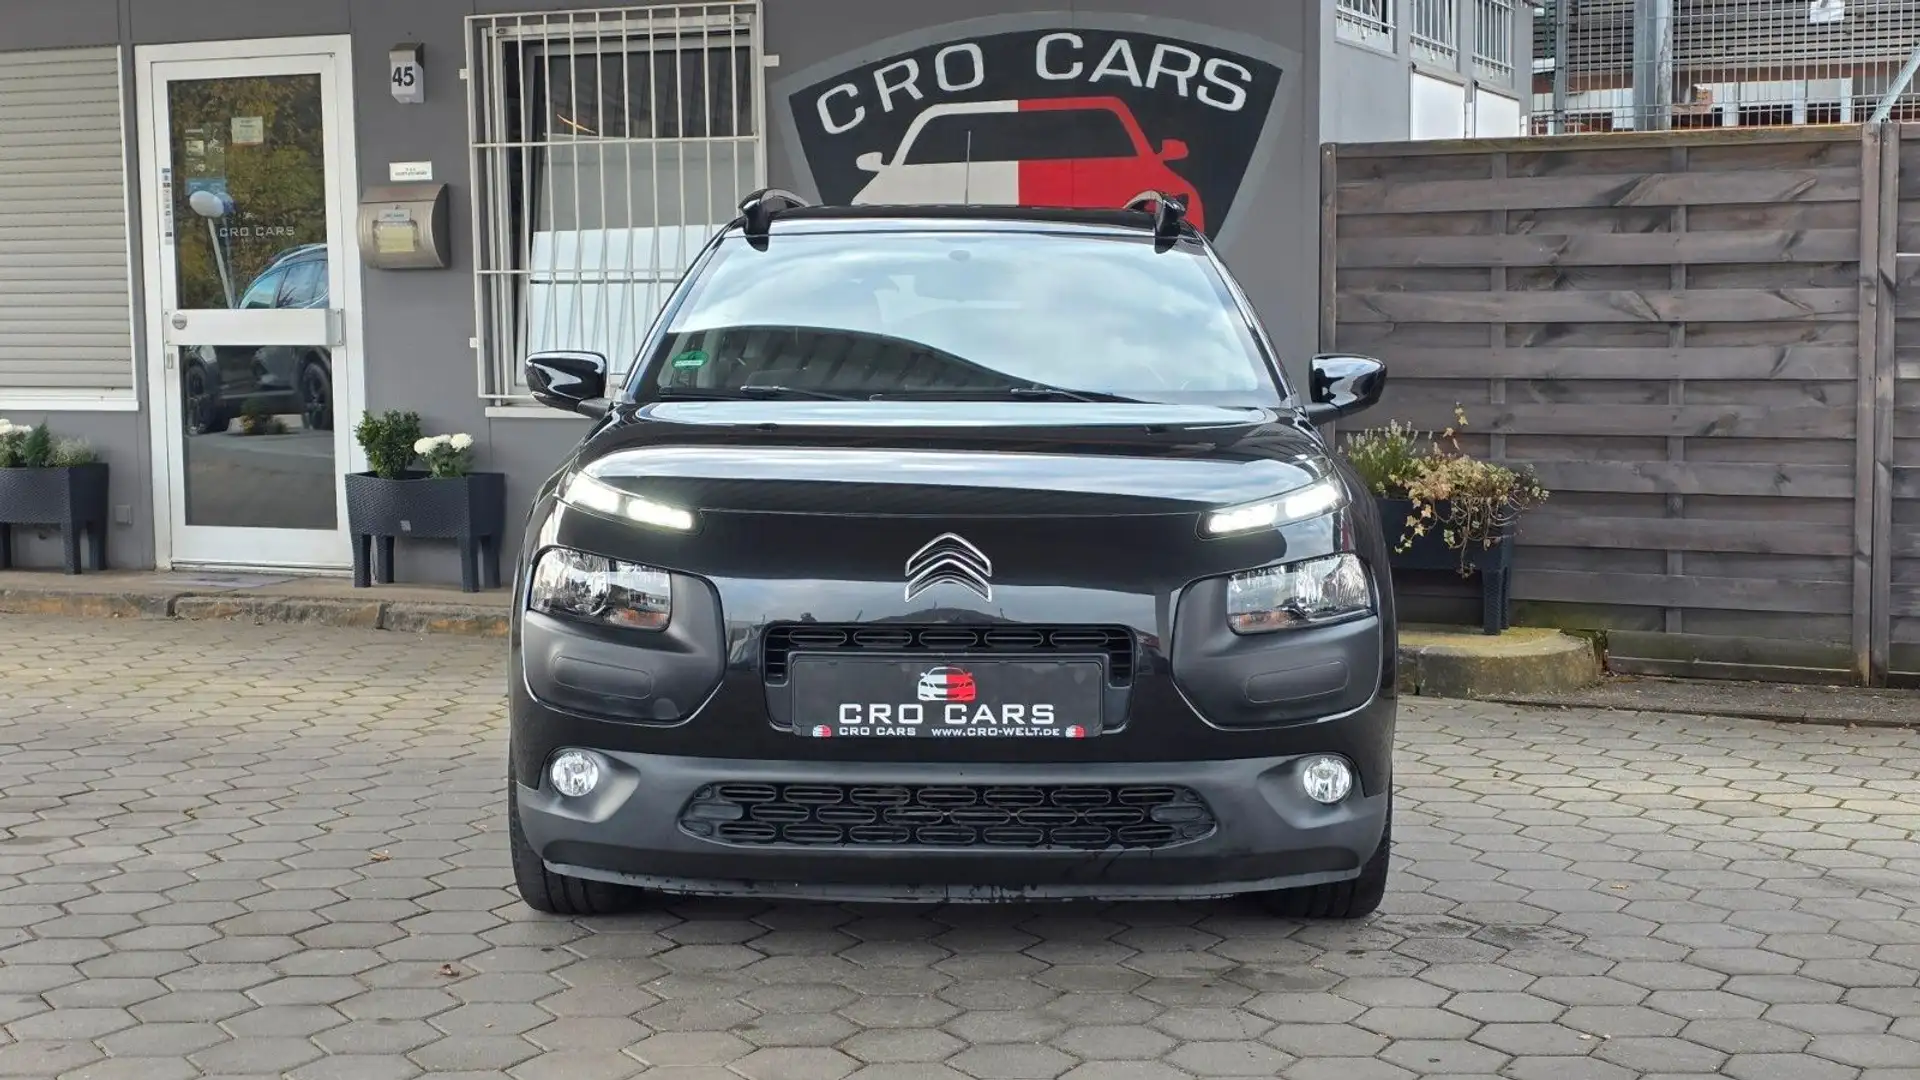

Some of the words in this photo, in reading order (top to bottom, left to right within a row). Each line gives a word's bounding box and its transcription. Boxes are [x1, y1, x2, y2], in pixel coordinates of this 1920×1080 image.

[392, 66, 415, 87] 45
[816, 42, 984, 135] CRO
[1035, 32, 1252, 112] CARS
[219, 226, 249, 237] CRO
[255, 226, 295, 237] CARS
[839, 703, 923, 724] CRO
[944, 703, 1054, 725] CARS
[839, 726, 870, 736] CRO
[876, 726, 916, 736] CARS
